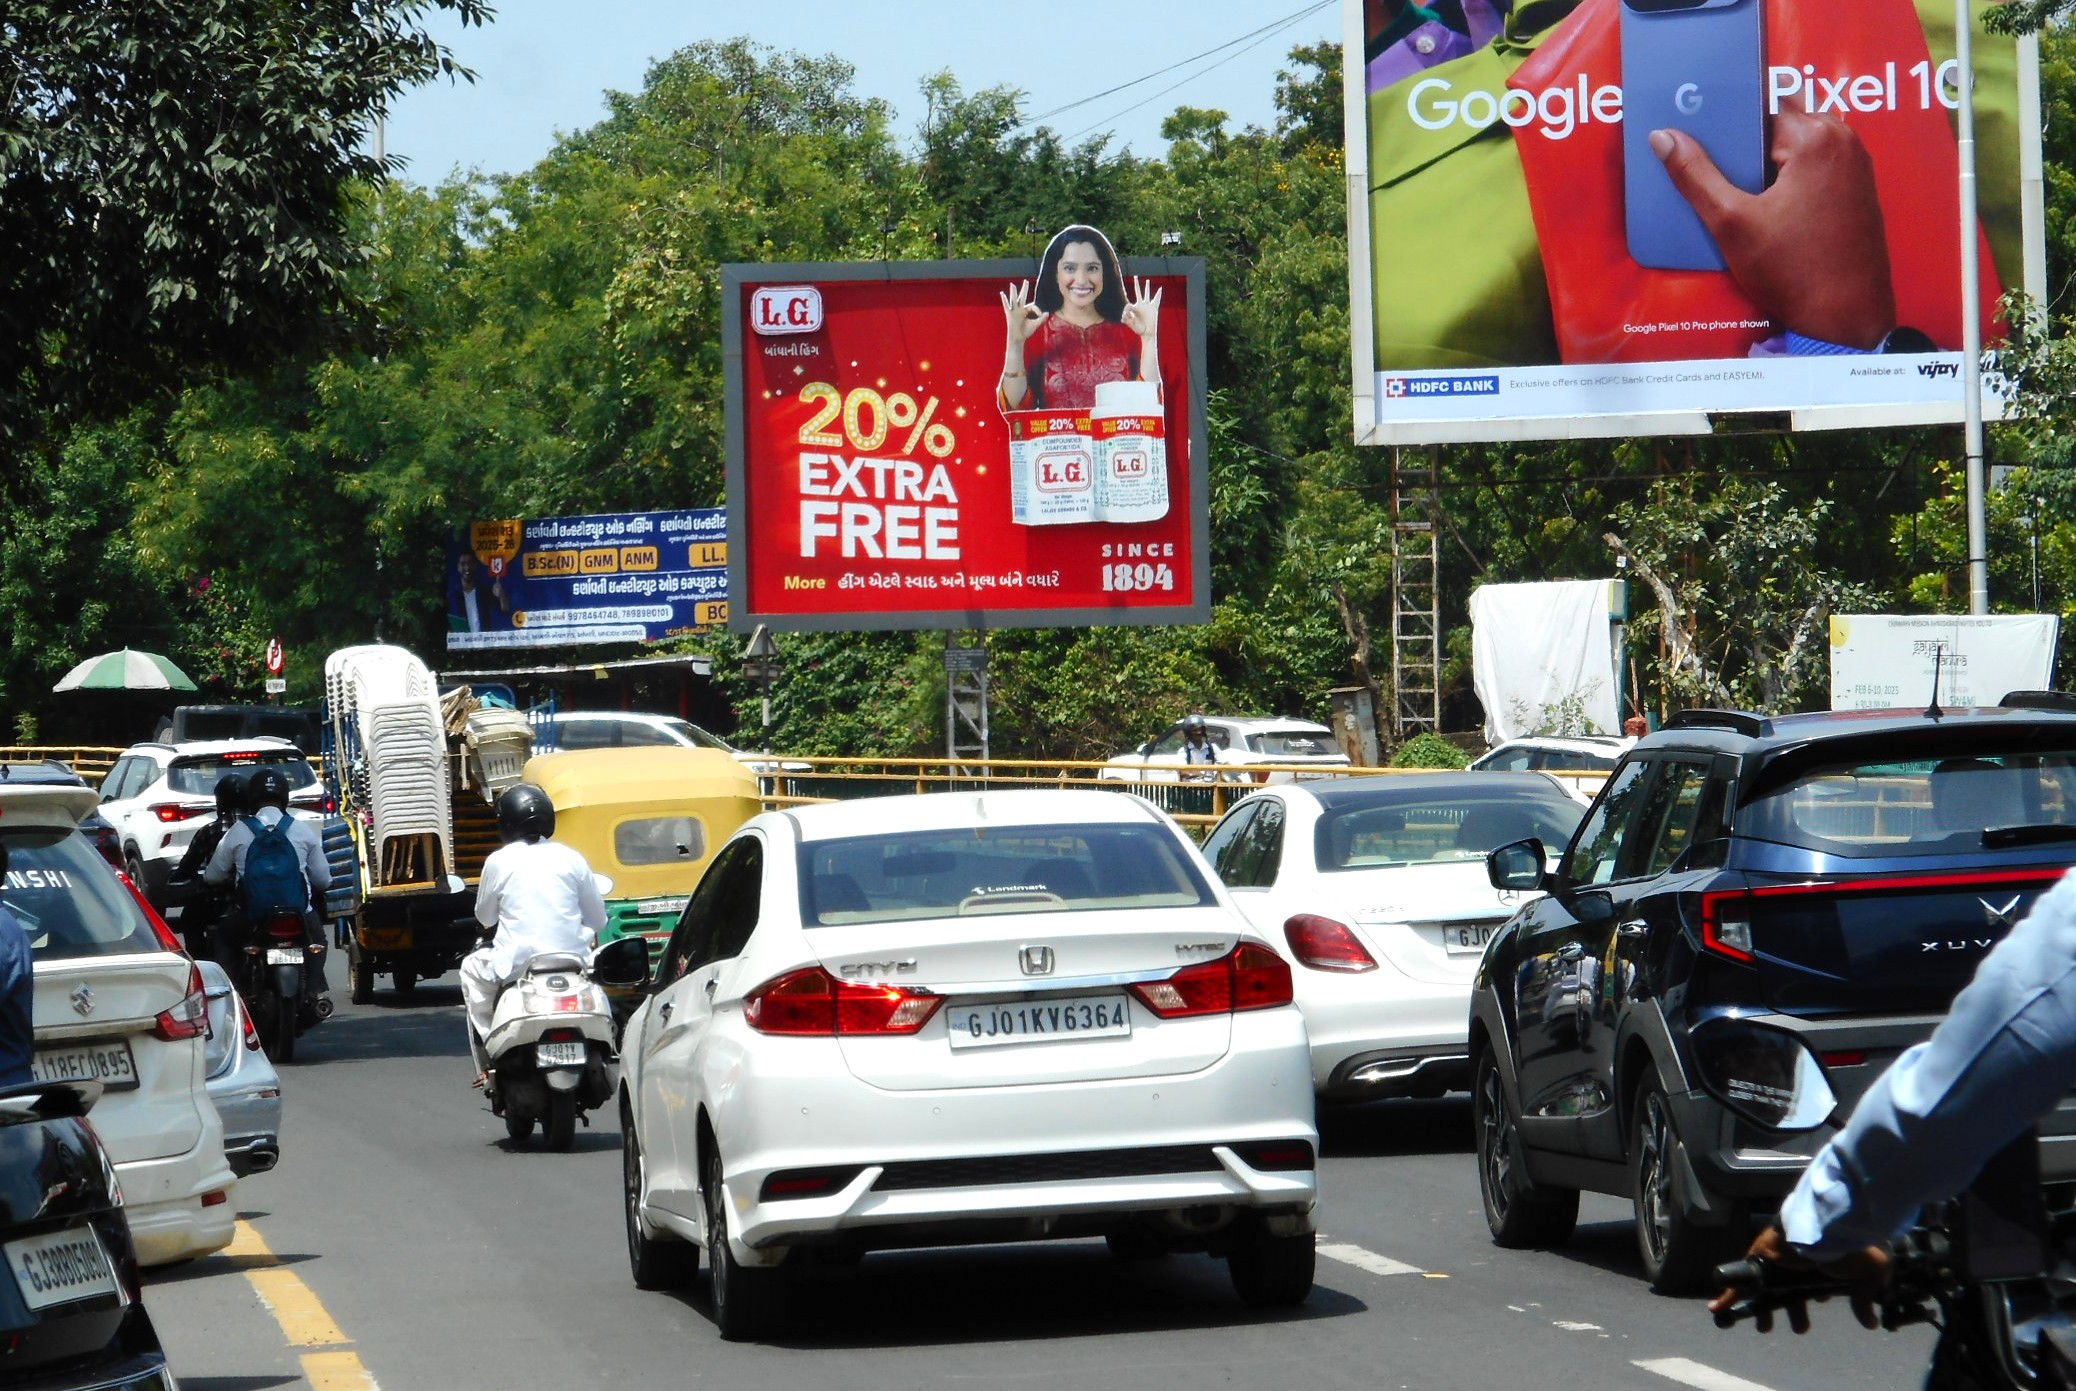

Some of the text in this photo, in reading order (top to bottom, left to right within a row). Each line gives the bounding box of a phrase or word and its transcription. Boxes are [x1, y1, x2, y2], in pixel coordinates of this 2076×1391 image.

[1408, 72, 1624, 141] Google
[1768, 60, 1896, 115] Pixel
[760, 297, 815, 326] L.G.
[1623, 319, 1770, 335] Google Pixel 10 Pro phone shown
[1509, 378, 1550, 389] Exclusive
[1551, 377, 1578, 388] offers
[1580, 378, 1593, 387] on
[1595, 376, 1621, 387] HDFC
[1622, 375, 1645, 386] Bank
[1645, 374, 1674, 384] Credit
[1675, 373, 1702, 384] Cards
[1703, 371, 1721, 382] and
[1850, 367, 1906, 377] Available at:
[1410, 379, 1495, 394] HDFC BANK
[799, 382, 955, 457] 20%
[1049, 418, 1074, 431] 20%
[1116, 418, 1141, 431] 20%
[1042, 461, 1086, 484] L.G.
[1116, 459, 1144, 473] L.G.
[799, 453, 958, 502] EXTRA
[799, 500, 960, 560] FREE
[624, 551, 654, 566] ANM
[1102, 543, 1174, 558] SINCE
[527, 554, 575, 571] B.Sc.(N)
[584, 553, 613, 568] GNM
[784, 575, 826, 590] More
[837, 570, 1060, 592] હીંગ એટલે સ્વાદ અને મૂલ્ય બંને વધારે
[1102, 563, 1174, 592] 1894
[1855, 685, 1866, 695] FEB
[0, 870, 73, 890] NSHI
[987, 883, 1048, 893] Landmark
[1921, 938, 1993, 952] XUV
[968, 1003, 1124, 1039] GJ01KV6364
